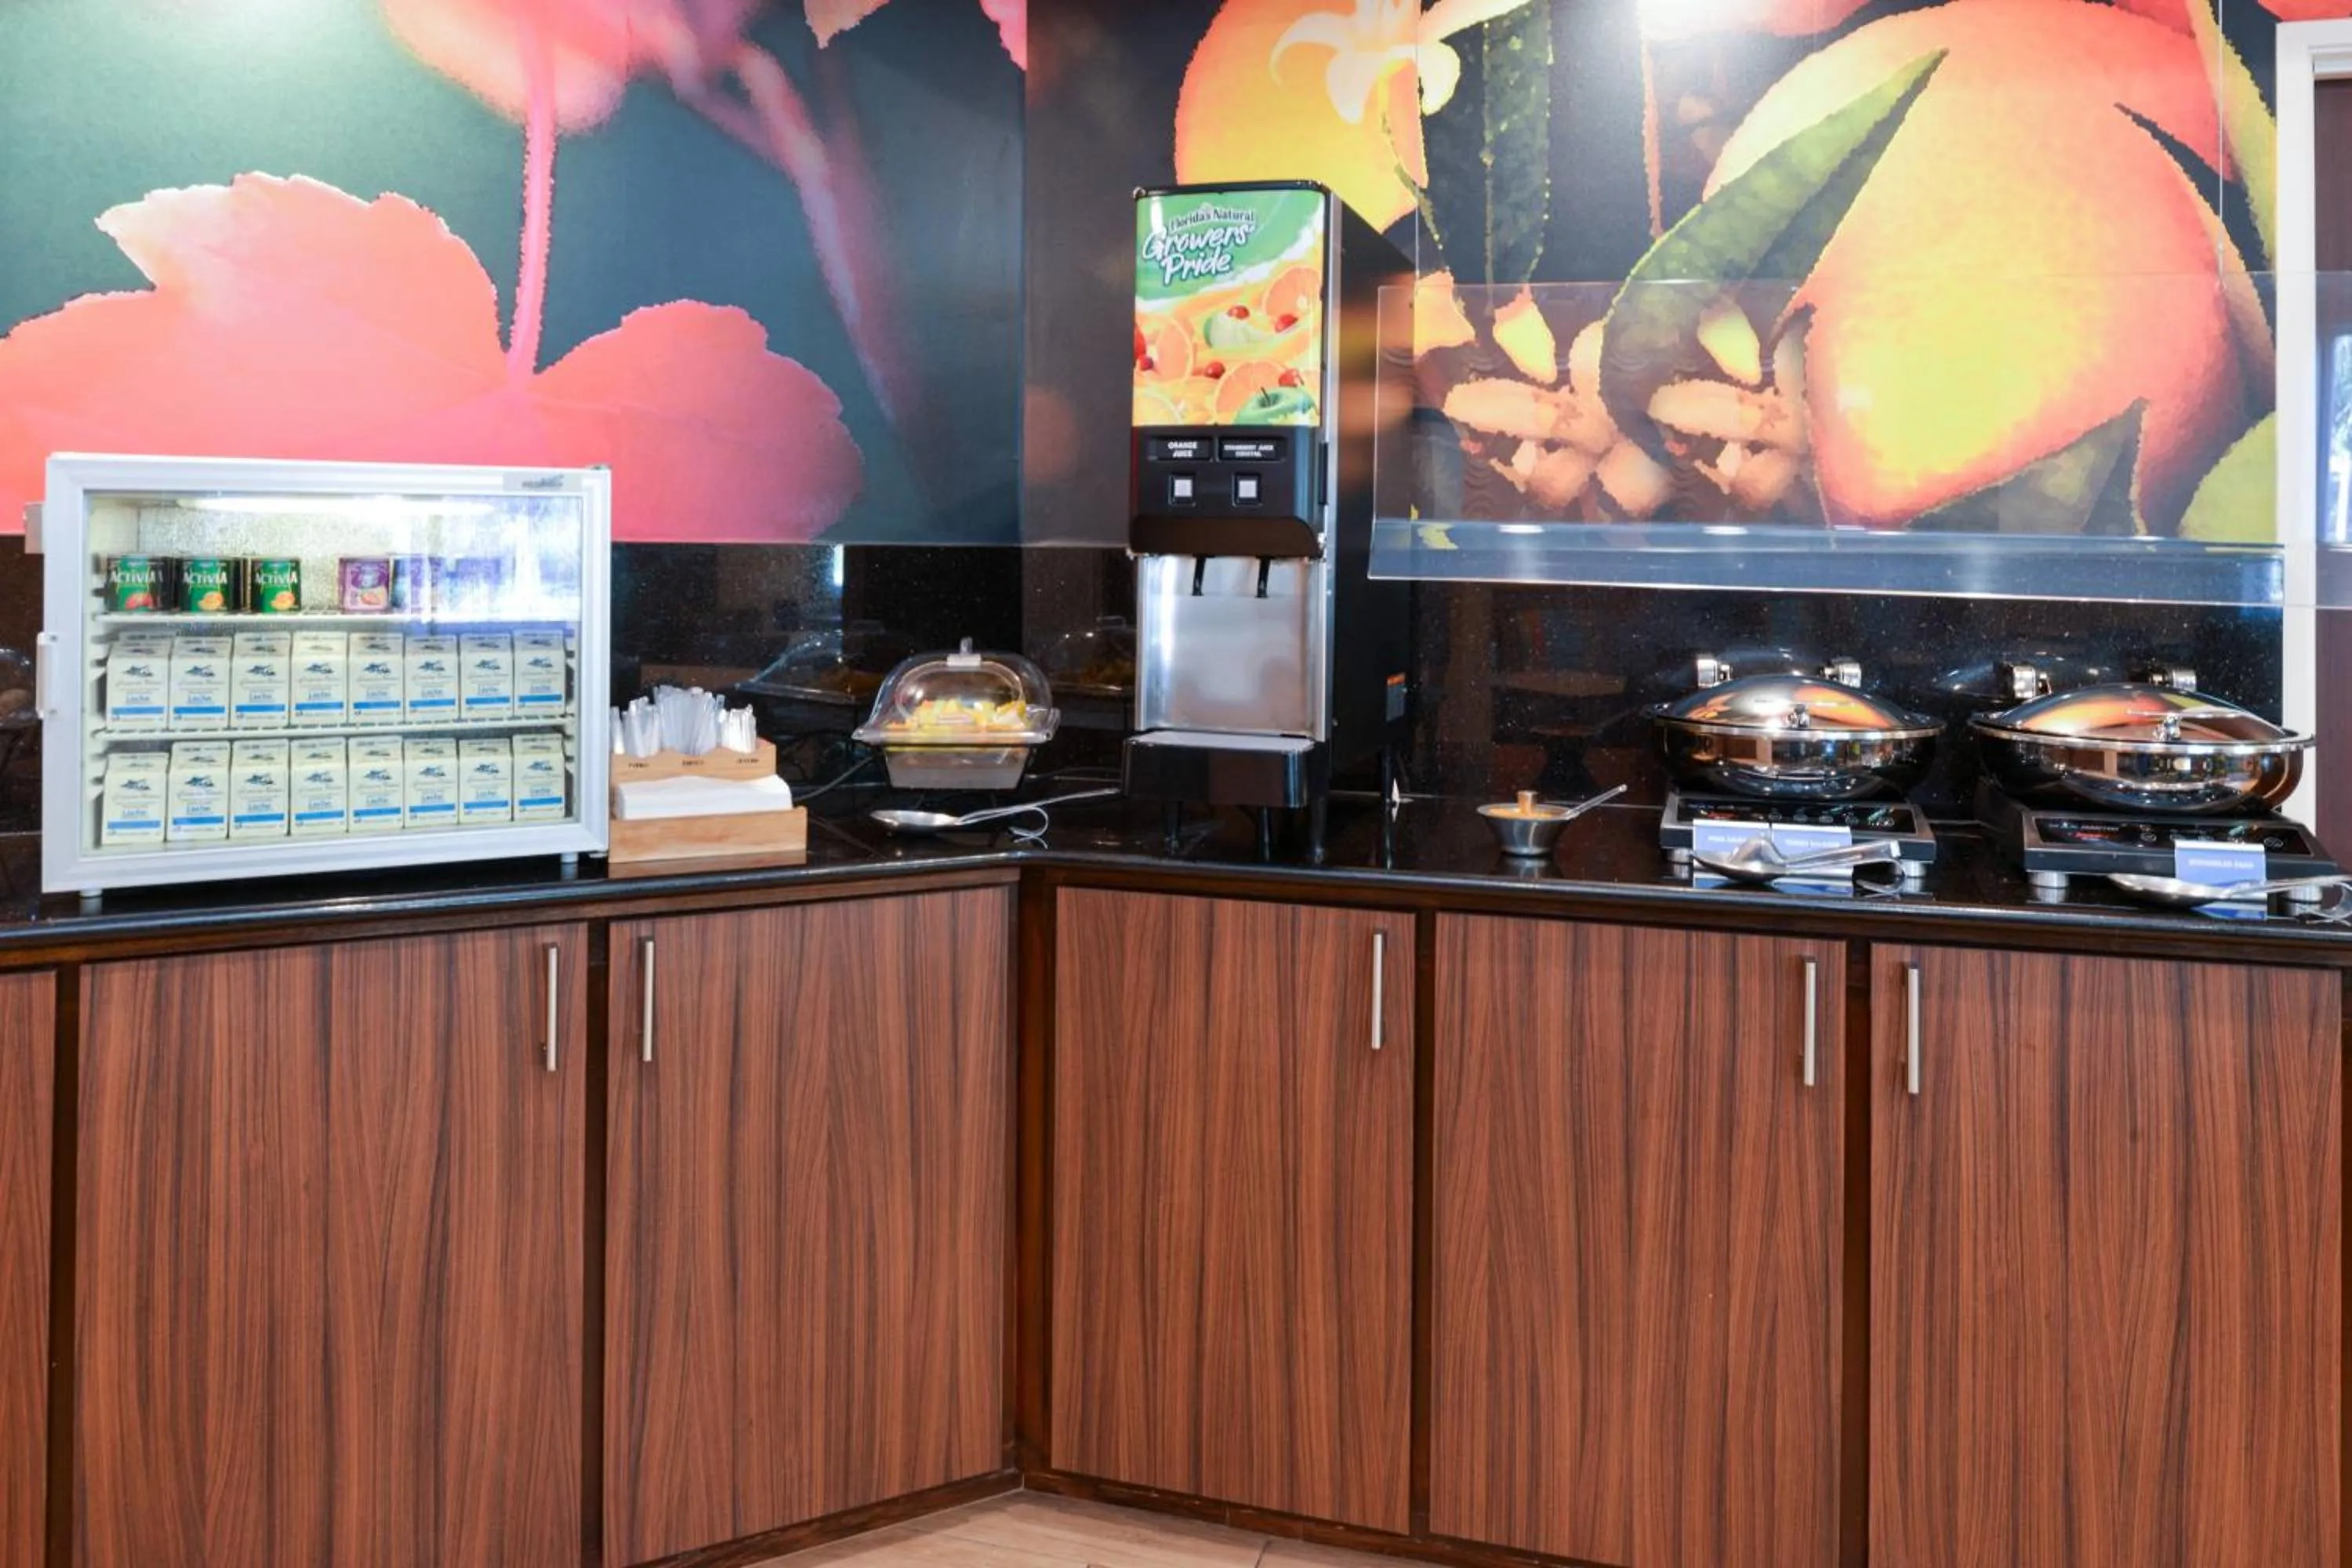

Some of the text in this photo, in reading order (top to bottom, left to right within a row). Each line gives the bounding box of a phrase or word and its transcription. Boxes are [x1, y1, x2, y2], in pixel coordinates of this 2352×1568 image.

[1170, 208, 1255, 230] Florida's Natural
[1161, 248, 1232, 285] Pride
[1167, 441, 1198, 449] ORANGE
